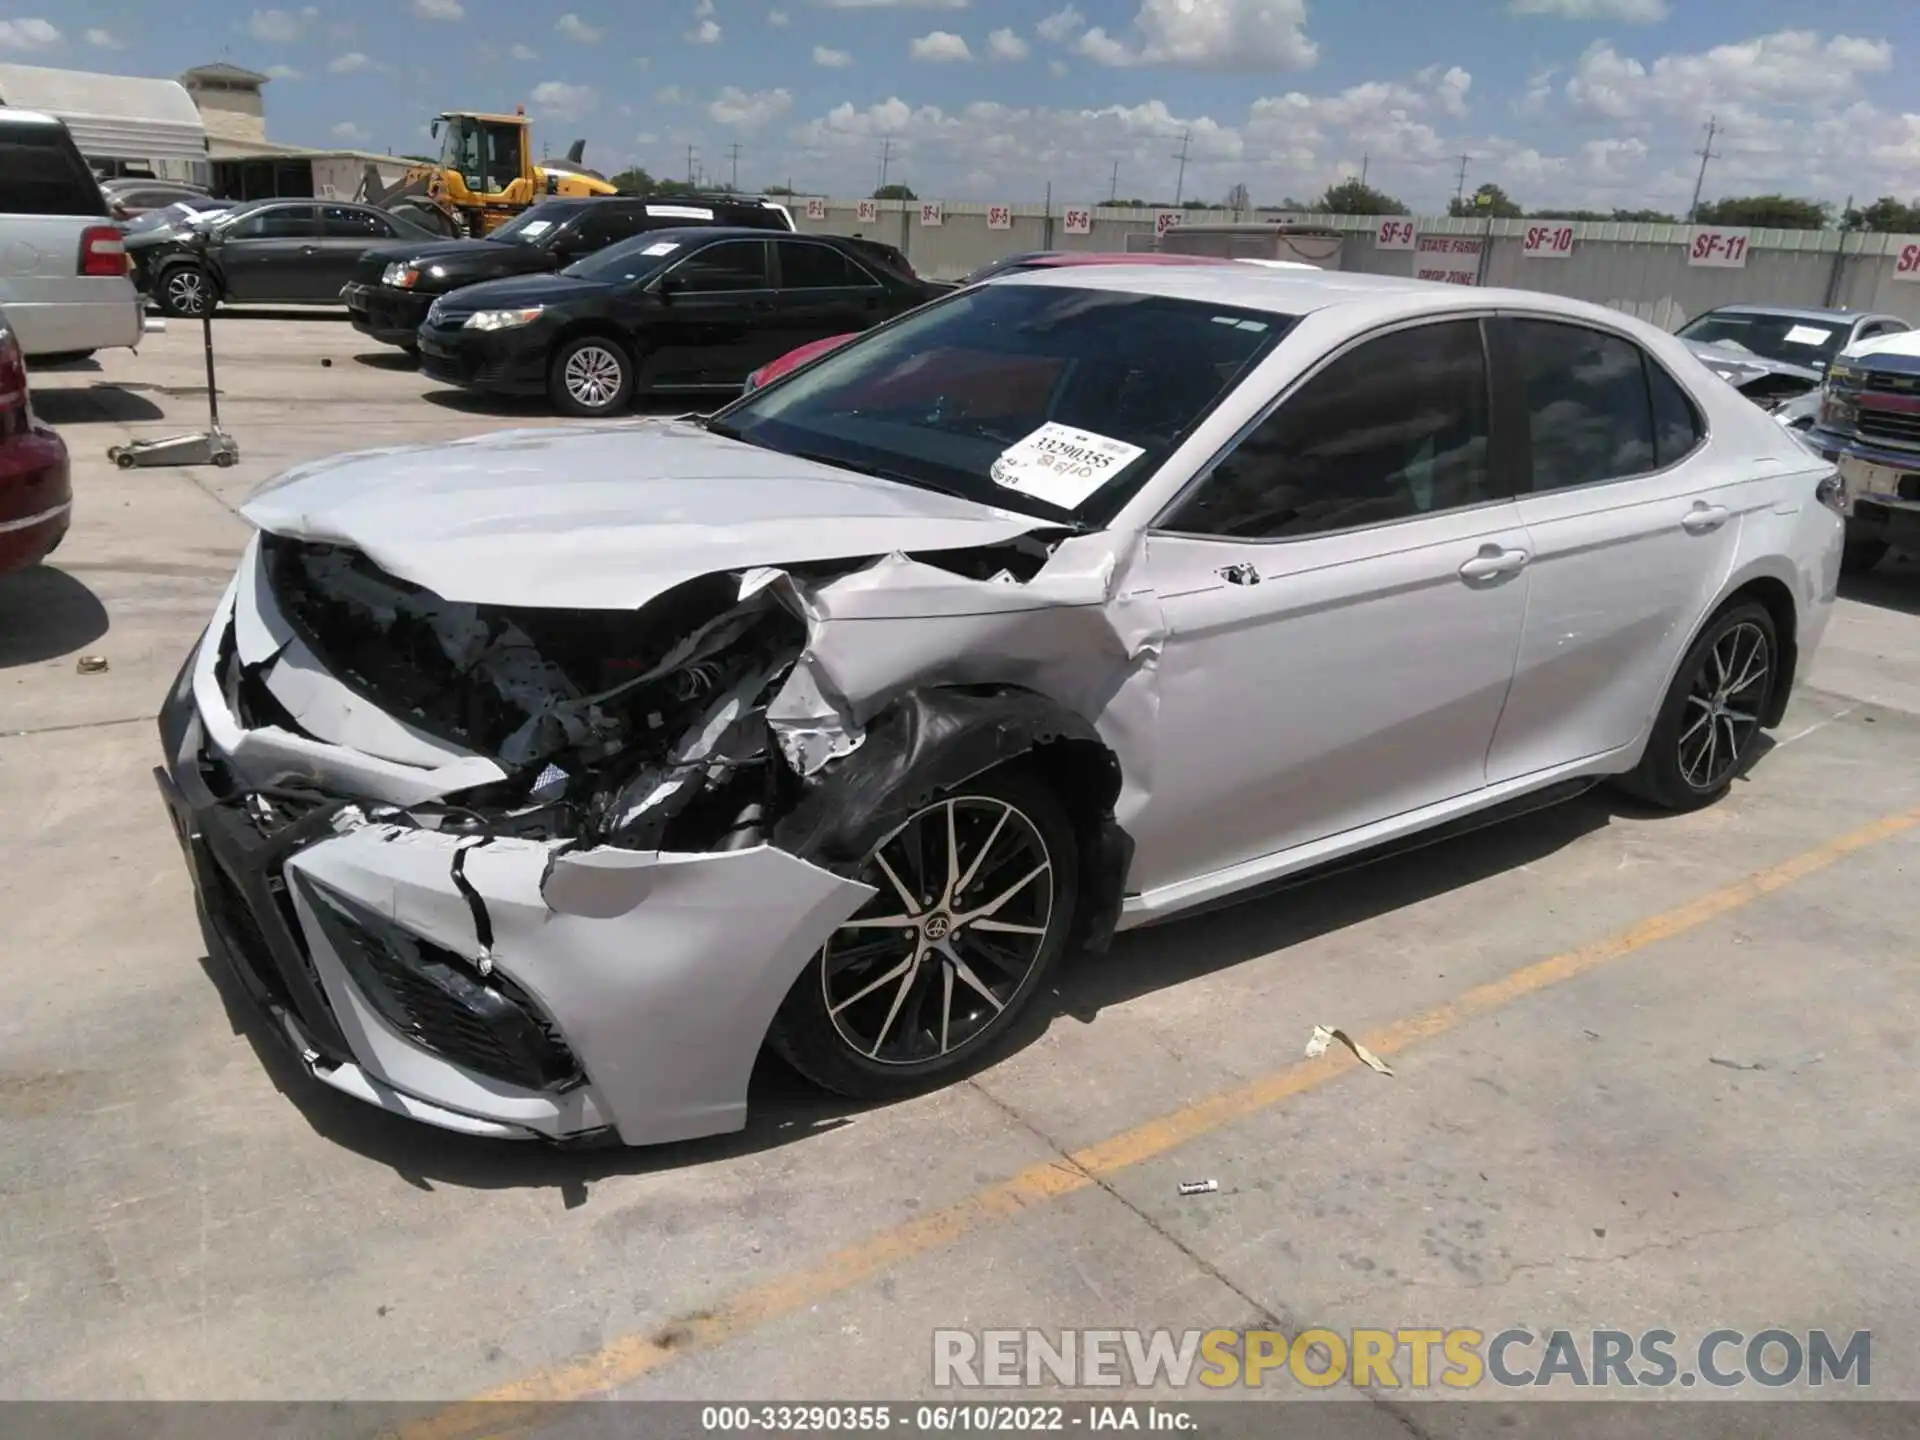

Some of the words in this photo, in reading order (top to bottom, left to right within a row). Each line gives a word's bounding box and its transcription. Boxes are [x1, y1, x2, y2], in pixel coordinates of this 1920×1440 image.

[1066, 210, 1089, 228] SF-6
[1380, 221, 1413, 244] SF-9
[1525, 227, 1573, 250] SF-10
[1420, 240, 1450, 252] STATE
[1692, 233, 1747, 260] SF-11
